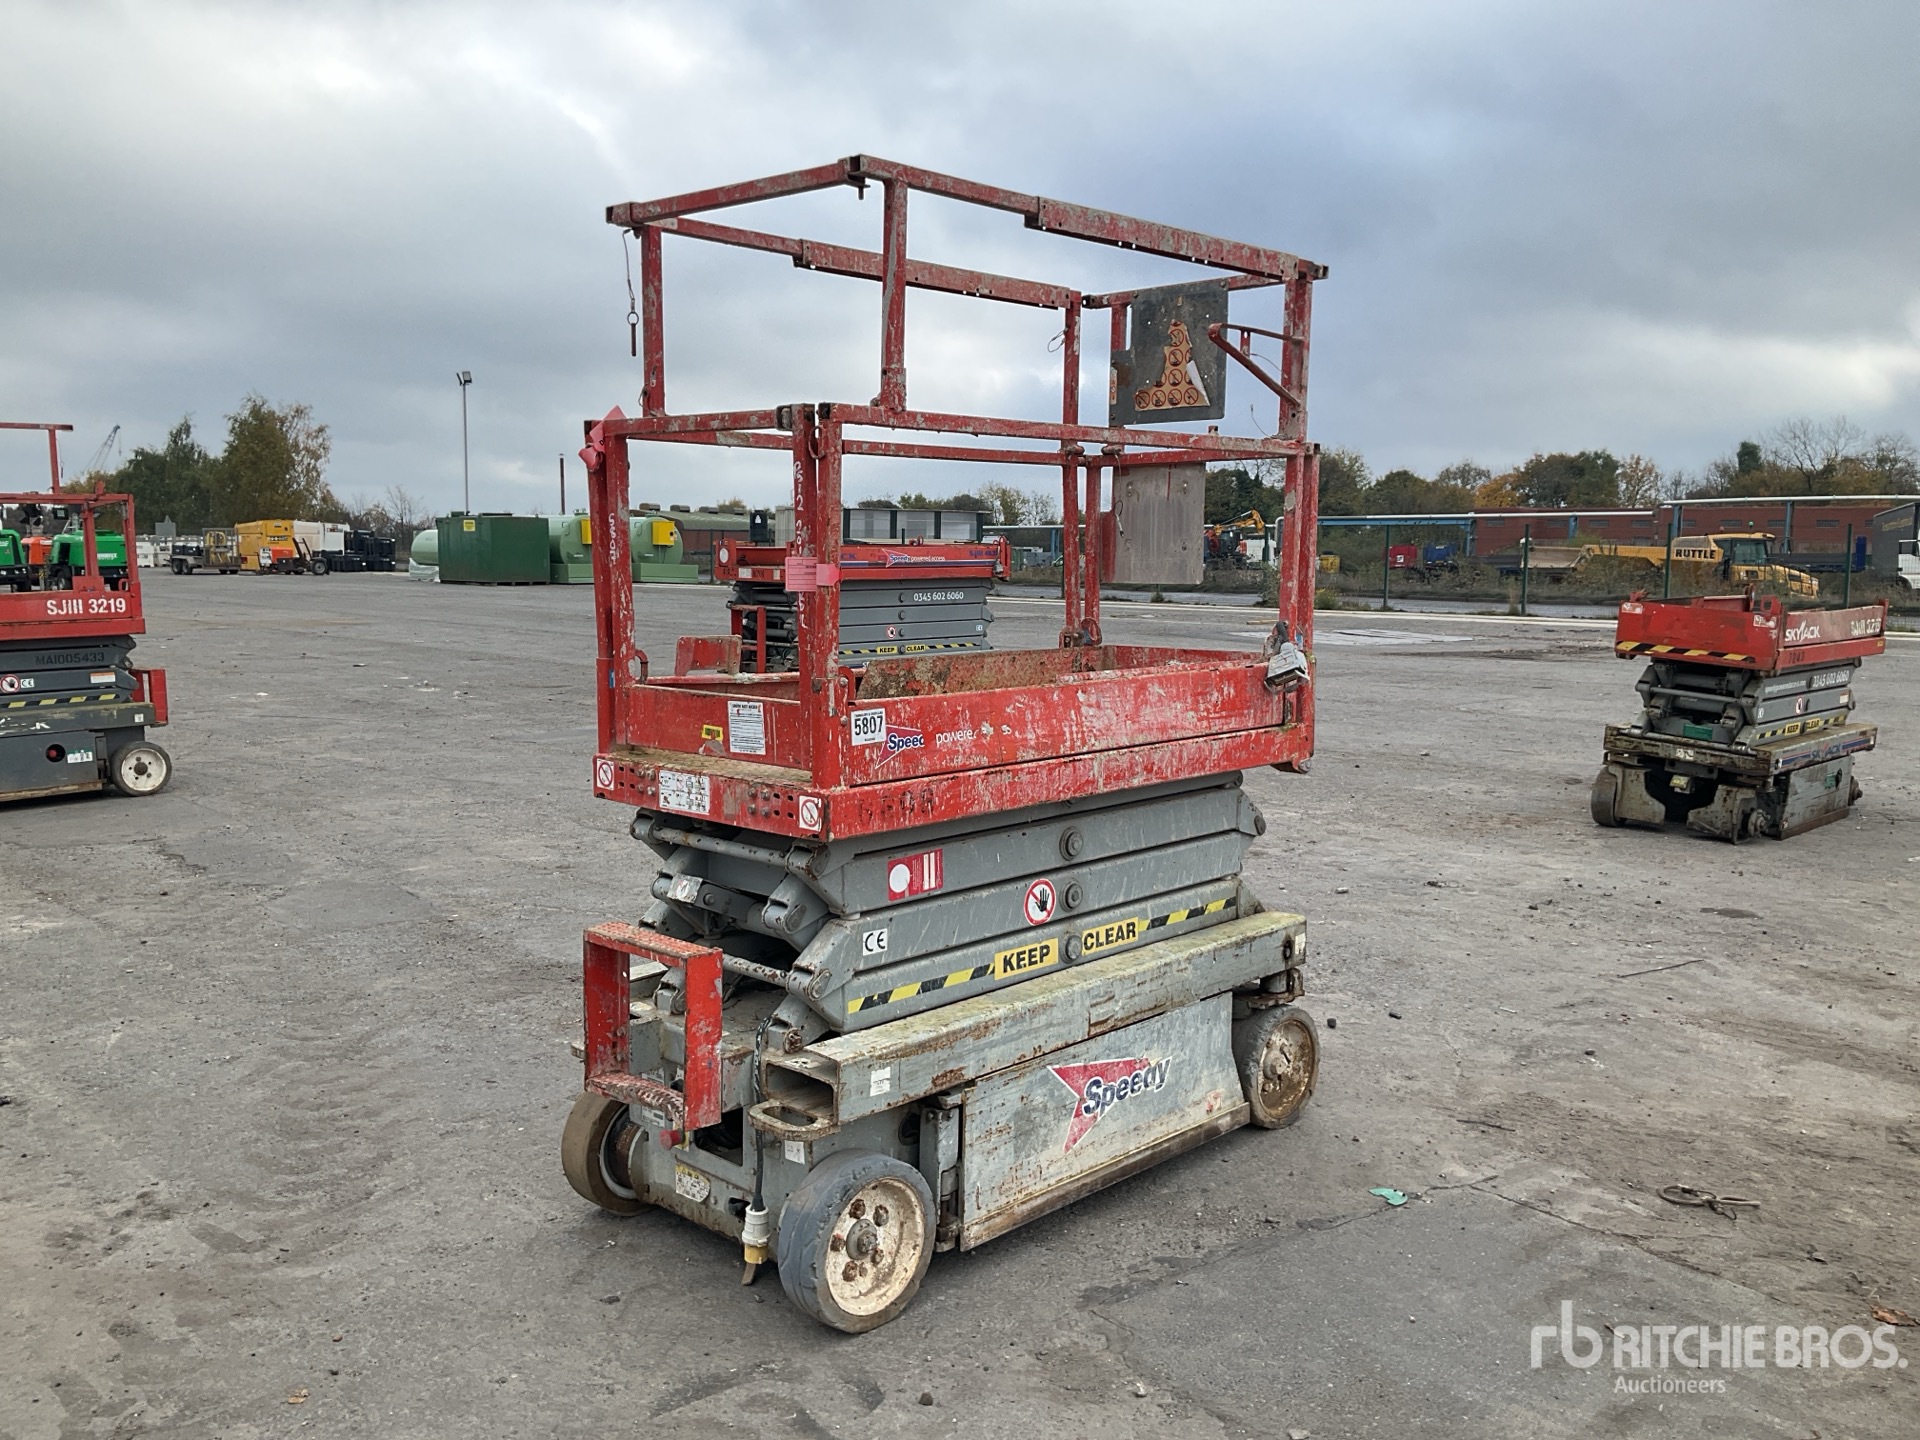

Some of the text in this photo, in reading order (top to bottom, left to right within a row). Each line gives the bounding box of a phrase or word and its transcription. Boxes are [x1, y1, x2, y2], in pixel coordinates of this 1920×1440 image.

[1675, 549, 1716, 560] RUTTLE
[88, 598, 126, 614] 3219
[913, 591, 964, 602] 0345 602 6060
[1785, 620, 1820, 642] SKYJACK
[854, 715, 883, 736] 5807
[1786, 724, 1799, 734] KEEP
[864, 931, 885, 953] CE
[1002, 922, 1136, 974] KEEP CLEAR
[1083, 1056, 1172, 1117] Speedy
